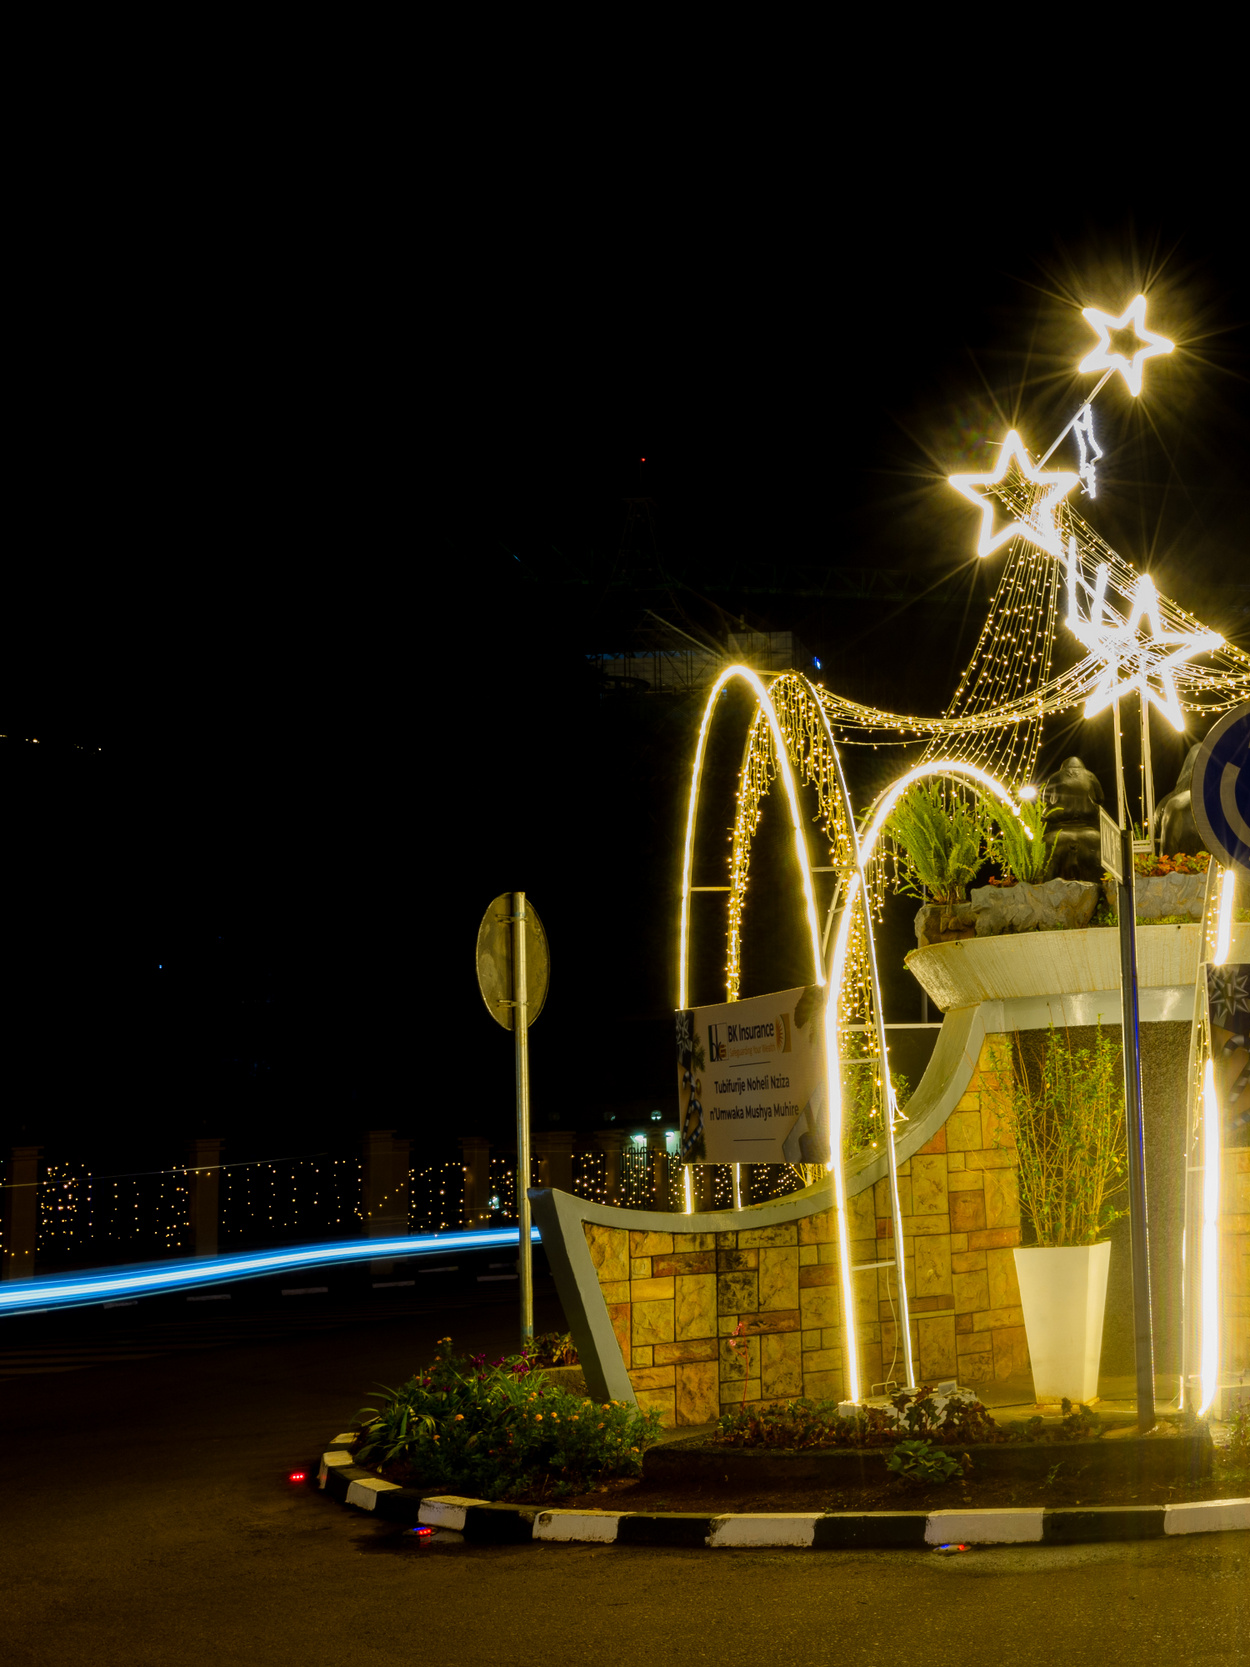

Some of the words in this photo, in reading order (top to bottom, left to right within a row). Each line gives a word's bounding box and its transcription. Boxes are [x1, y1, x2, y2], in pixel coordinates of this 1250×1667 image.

[728, 1025, 738, 1042] BK
[739, 1022, 774, 1041] Insurance
[747, 1074, 769, 1091] Noheli
[771, 1073, 789, 1089] Nziza
[745, 1103, 772, 1121] Mushya
[773, 1101, 799, 1117] Muhire
